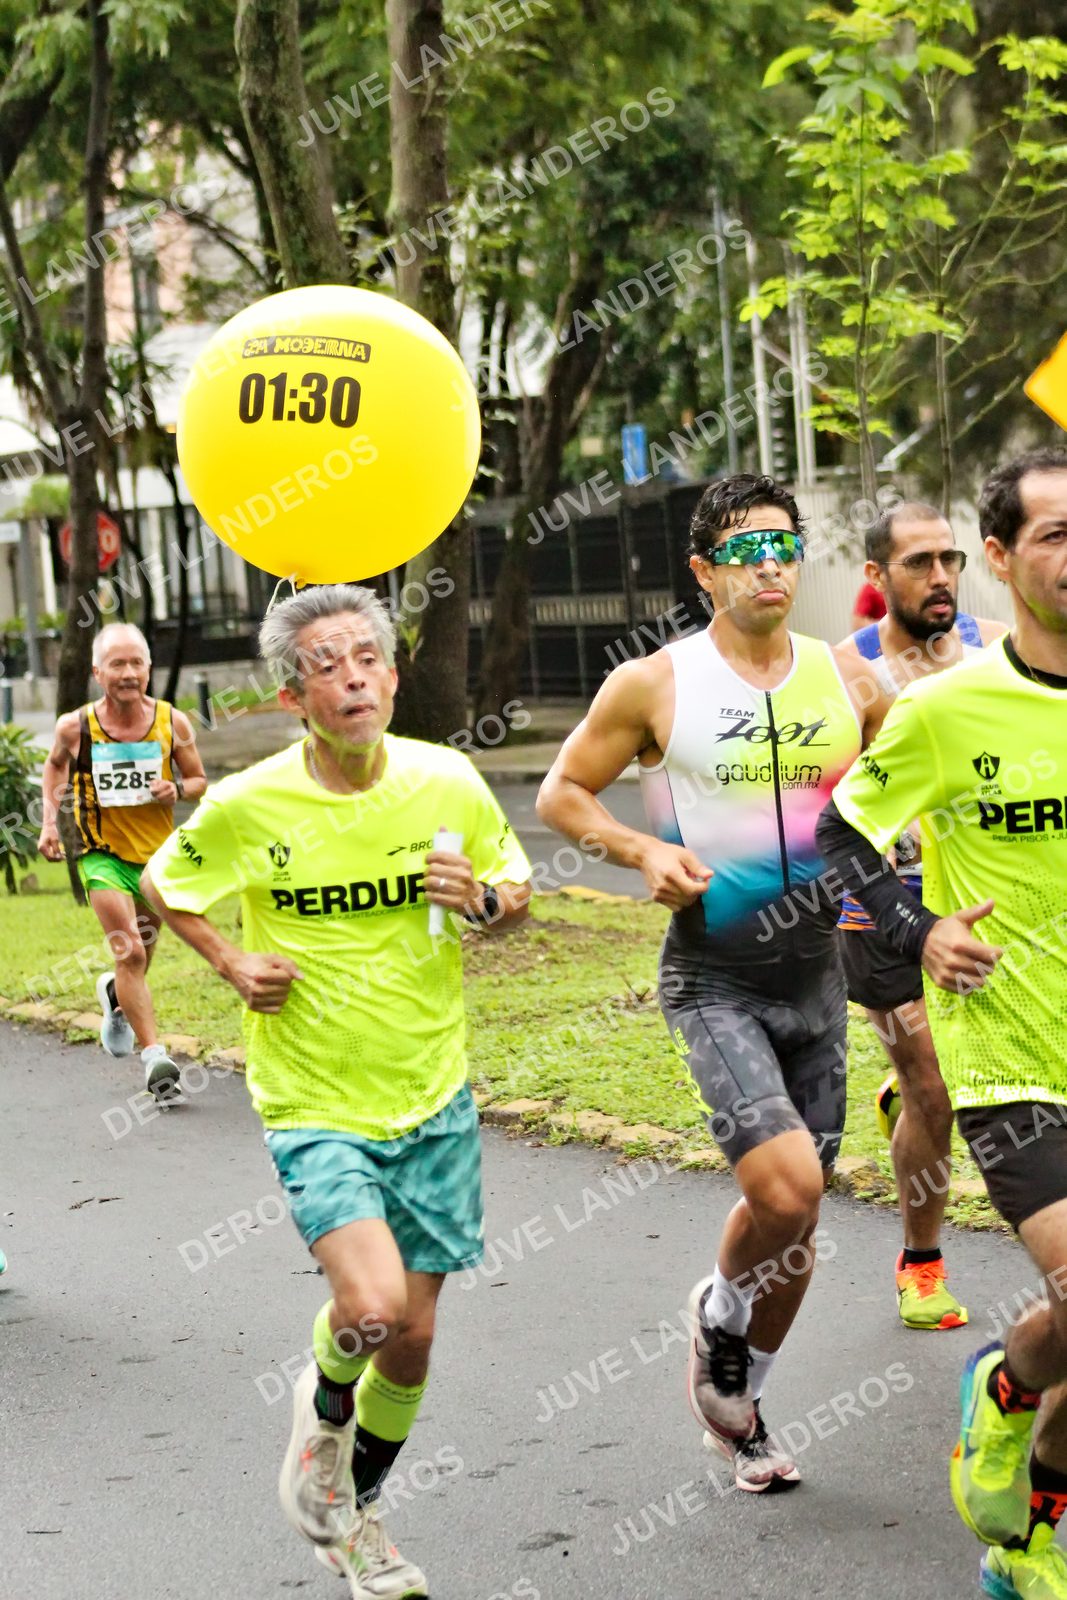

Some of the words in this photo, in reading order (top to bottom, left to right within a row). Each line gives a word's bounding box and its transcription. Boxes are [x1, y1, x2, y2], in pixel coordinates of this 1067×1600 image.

[239, 372, 361, 428] 01:30
[720, 708, 755, 718] TEAM
[99, 771, 157, 790] 5285
[716, 761, 822, 786] gaudium
[978, 796, 1067, 834] PER
[410, 840, 434, 852] BRO
[270, 872, 427, 916] PERDUR
